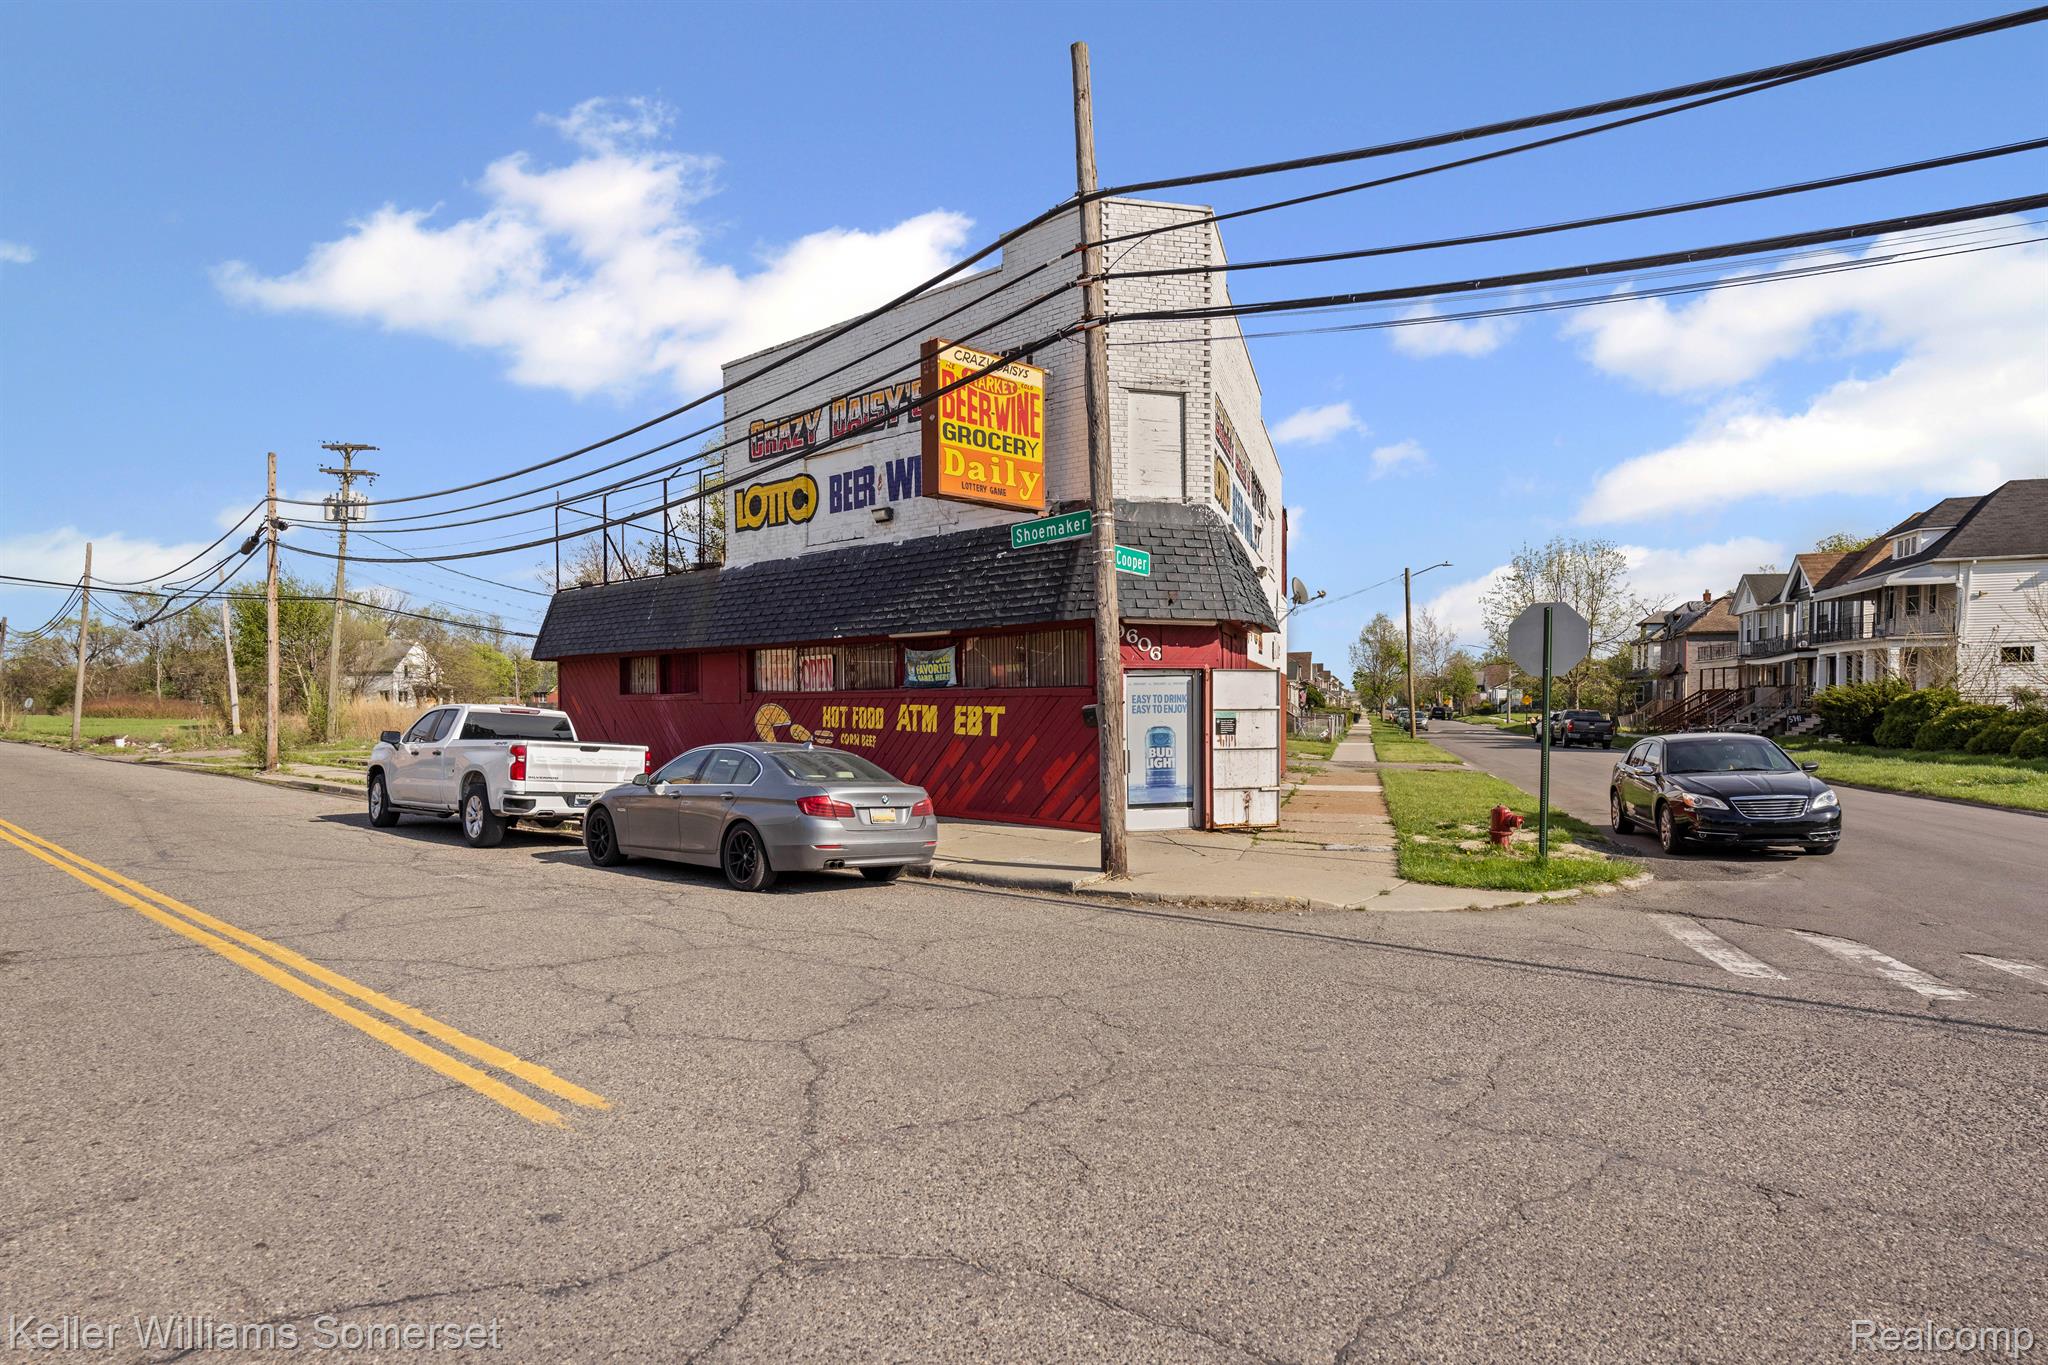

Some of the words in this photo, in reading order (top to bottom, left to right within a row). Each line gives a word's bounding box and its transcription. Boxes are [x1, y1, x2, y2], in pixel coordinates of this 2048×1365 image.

[954, 349, 994, 368] CRAZY
[749, 406, 823, 461] CRAZY
[942, 421, 1040, 459] GROCERY
[943, 447, 1041, 501] Daily
[829, 465, 876, 515] BEER
[961, 481, 987, 493] LOTTERY
[989, 486, 1007, 497] GAME
[733, 473, 819, 533] LOTTO
[1015, 517, 1088, 544] Shoemaker
[1116, 550, 1147, 571] Cooper
[916, 663, 951, 675] FAVORITE
[1131, 694, 1151, 704] EASY
[1153, 694, 1163, 704] TO
[1164, 693, 1187, 704] DRINK
[1131, 704, 1151, 714] EASY
[1153, 704, 1163, 714] TO
[1164, 704, 1187, 714] ENJOY
[822, 705, 848, 729] HOT
[851, 706, 885, 730] FOOD
[896, 704, 938, 733] ATM
[953, 705, 1006, 737] EBT
[840, 732, 860, 746] CORN
[861, 734, 877, 748] BEEF
[1149, 747, 1173, 758] BUD
